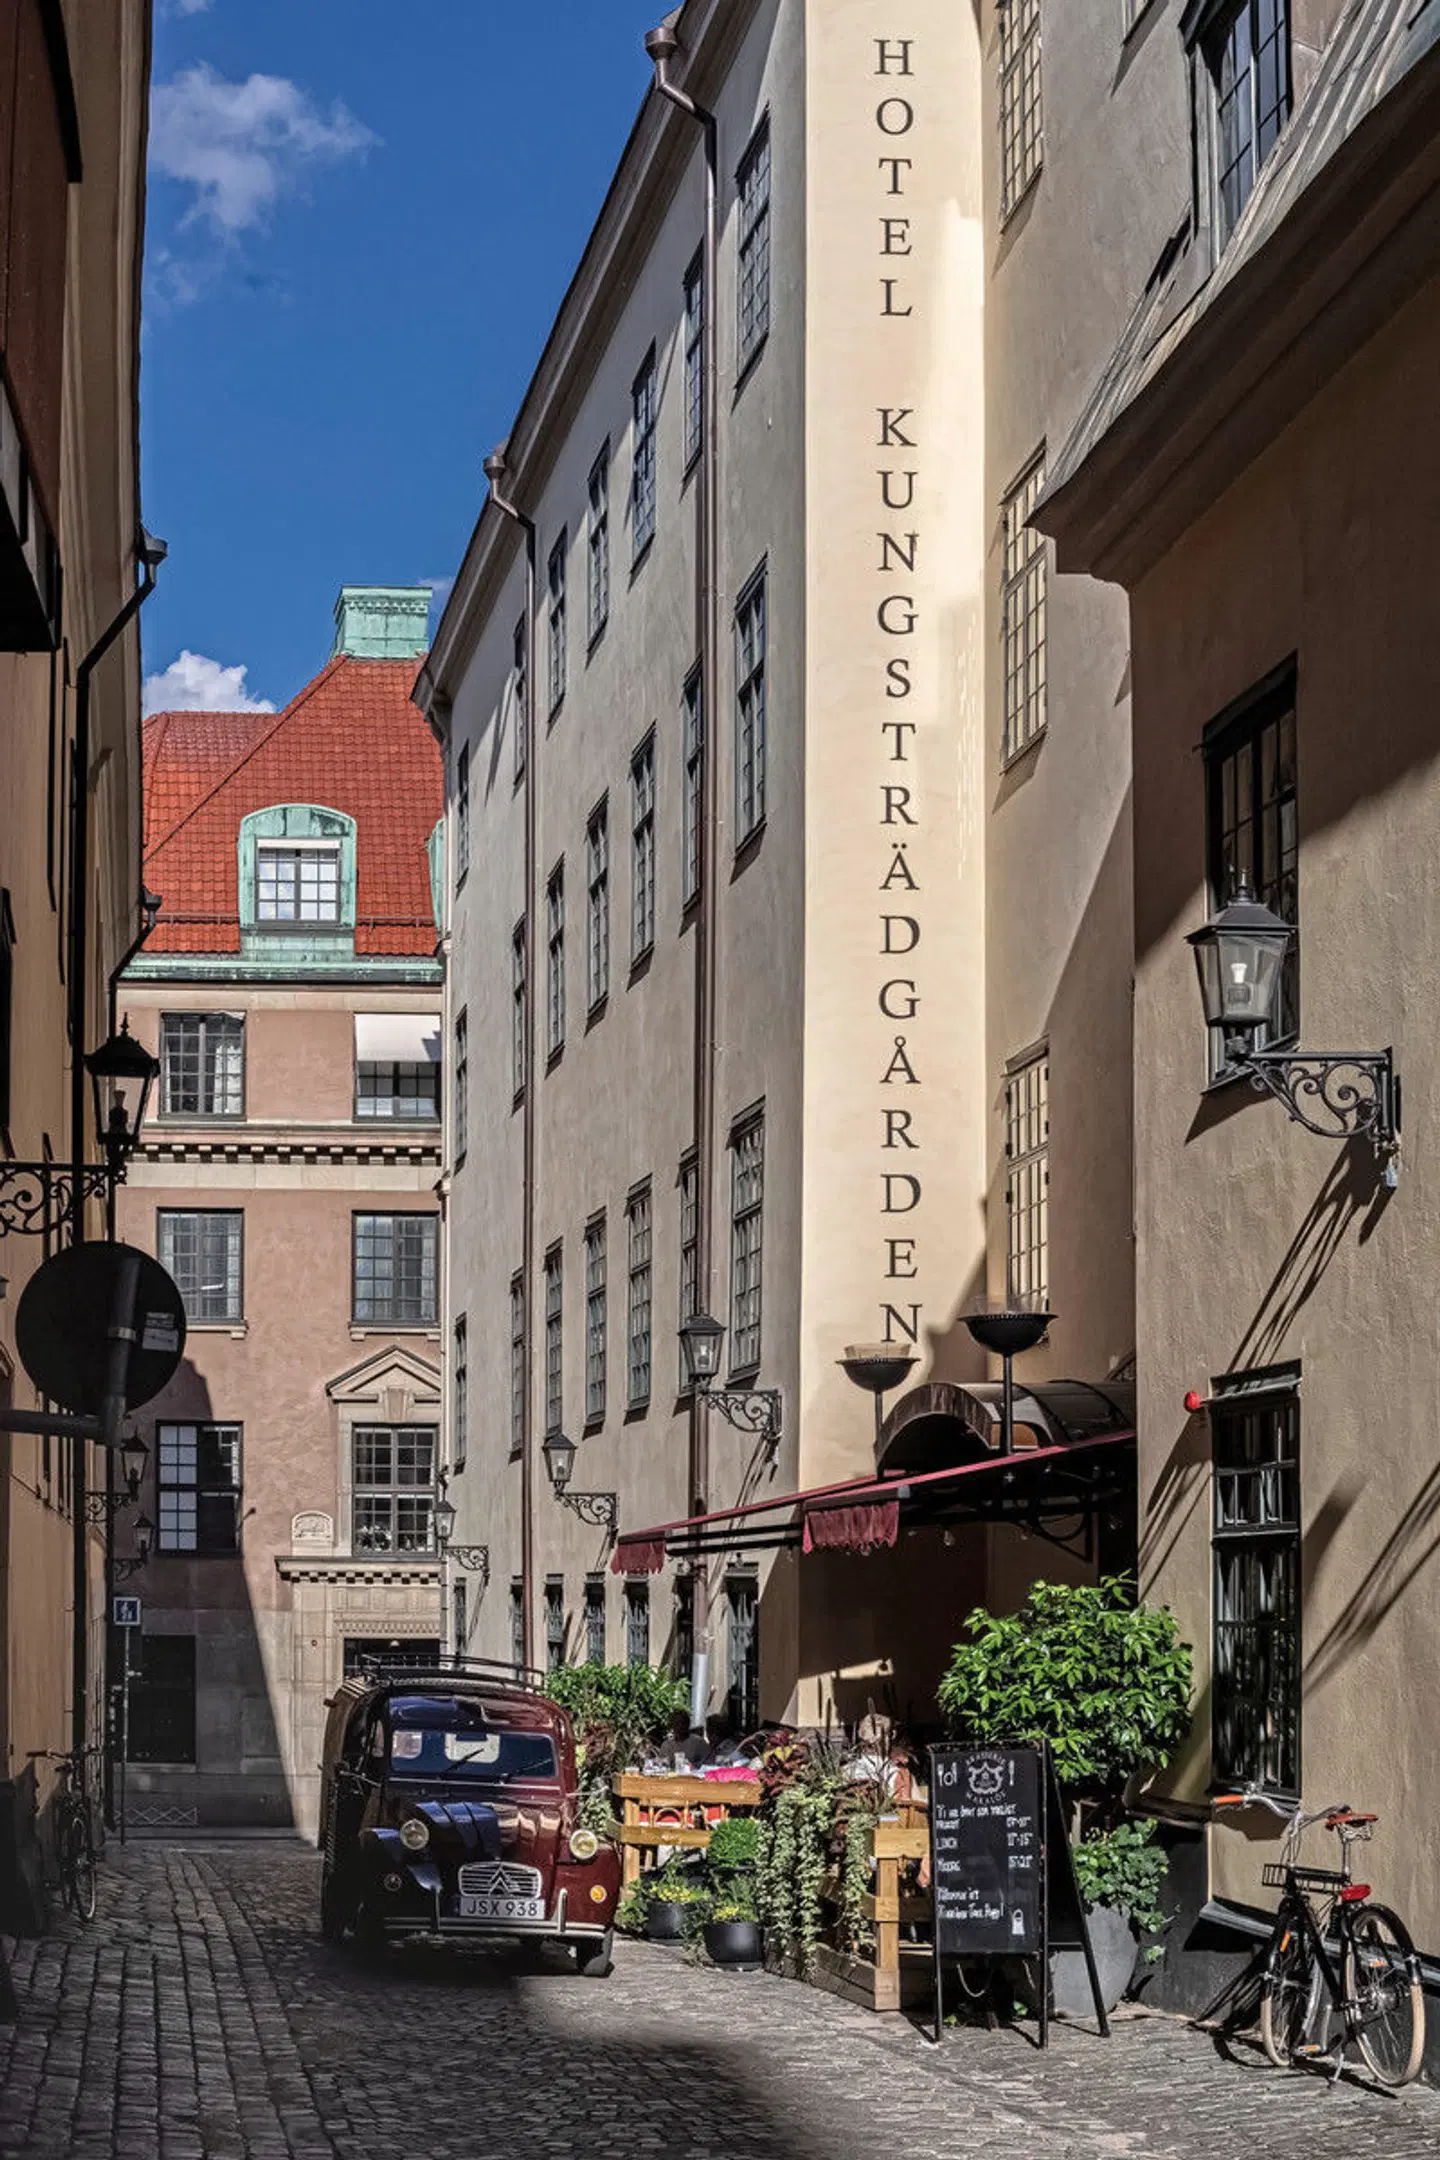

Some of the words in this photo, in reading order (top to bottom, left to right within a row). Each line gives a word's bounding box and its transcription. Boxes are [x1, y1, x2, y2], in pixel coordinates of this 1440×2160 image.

[874, 39, 914, 317] HOTEL
[877, 408, 922, 1345] KUNGSTRÄDGÅRDEN
[467, 1899, 500, 1916] JSX
[505, 1901, 538, 1917] 938
